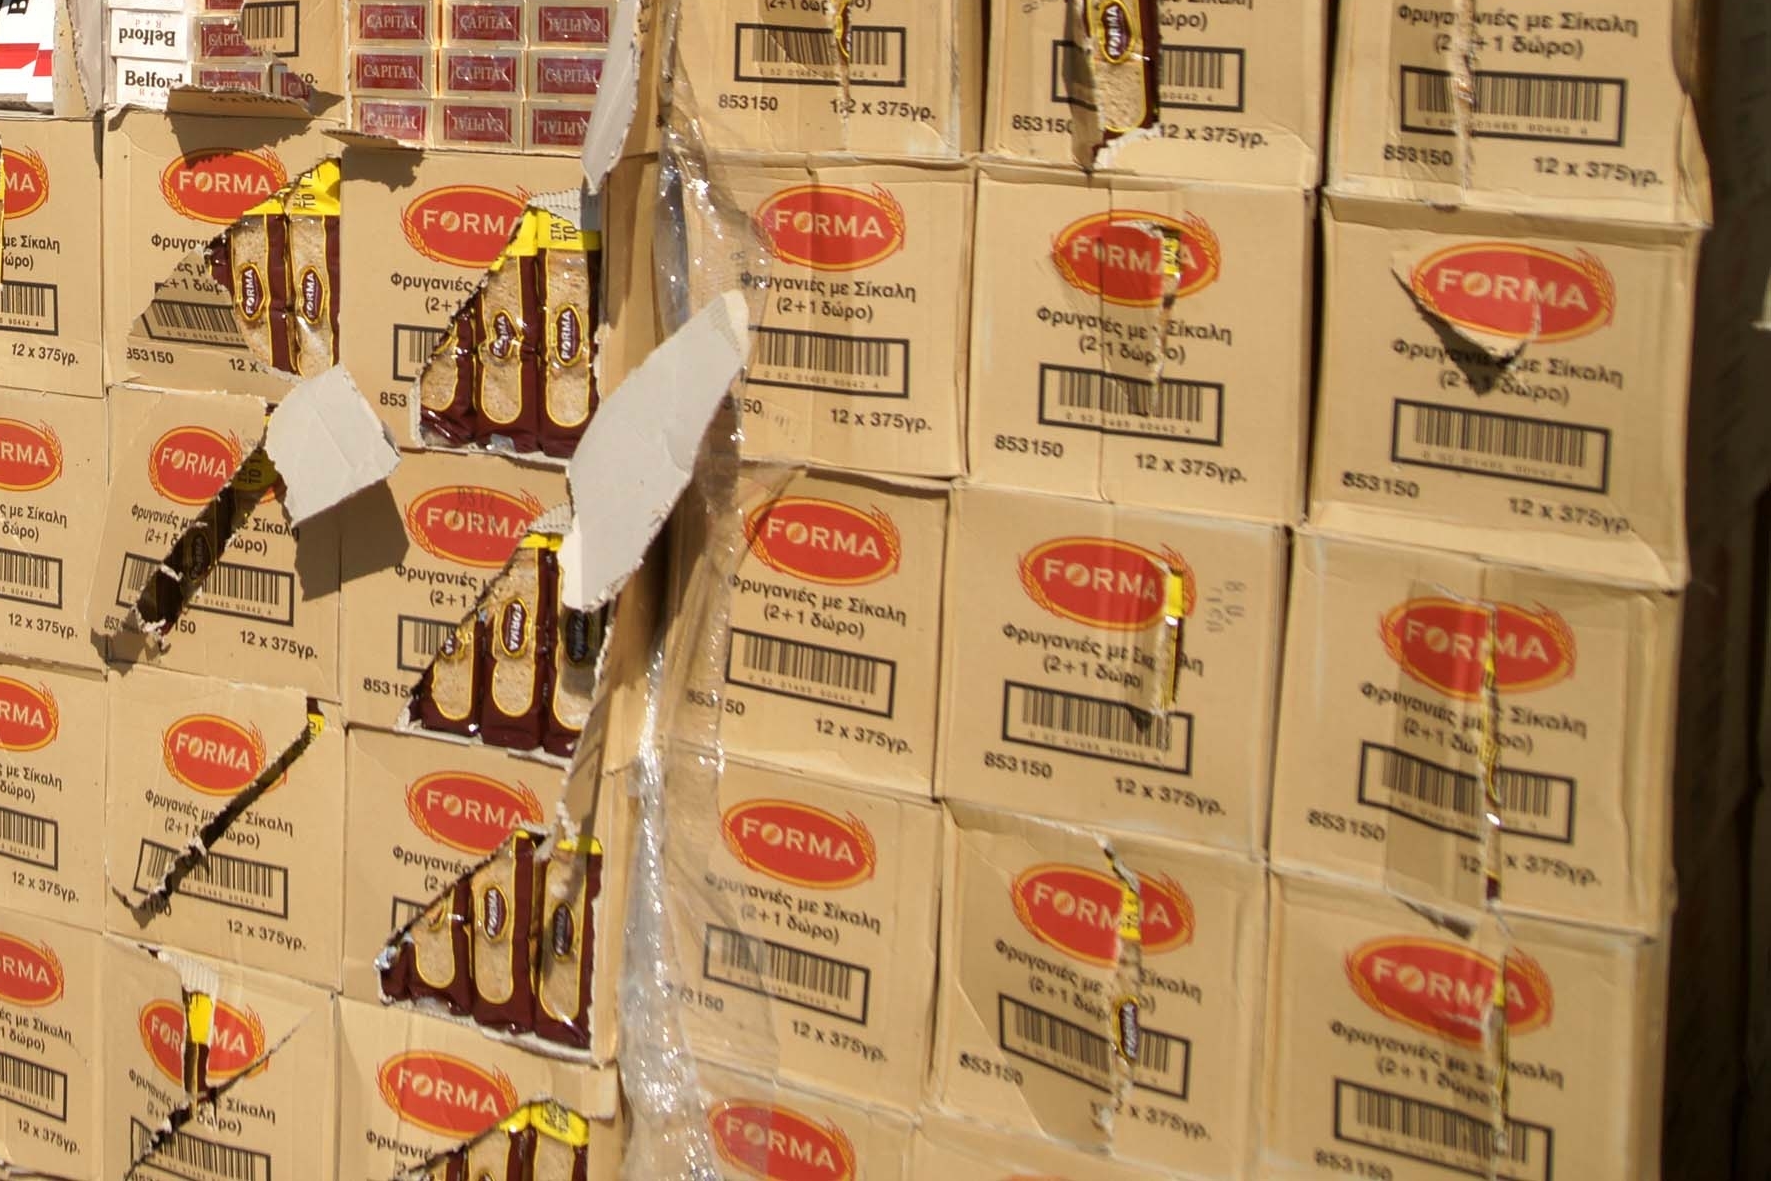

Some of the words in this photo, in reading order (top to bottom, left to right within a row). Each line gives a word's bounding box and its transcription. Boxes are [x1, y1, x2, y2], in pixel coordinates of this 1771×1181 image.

[119, 27, 176, 46] Belford
[364, 65, 414, 78] CAPITAL
[178, 172, 272, 194] FORMA
[774, 210, 884, 239] FORMA
[246, 270, 255, 313] FORMA
[1437, 270, 1589, 311] FORMA
[995, 435, 1064, 458] 853150
[1341, 472, 1419, 499] 853150
[766, 519, 881, 560] FORMA
[175, 735, 251, 766] FORMA
[741, 817, 856, 866] FORMA
